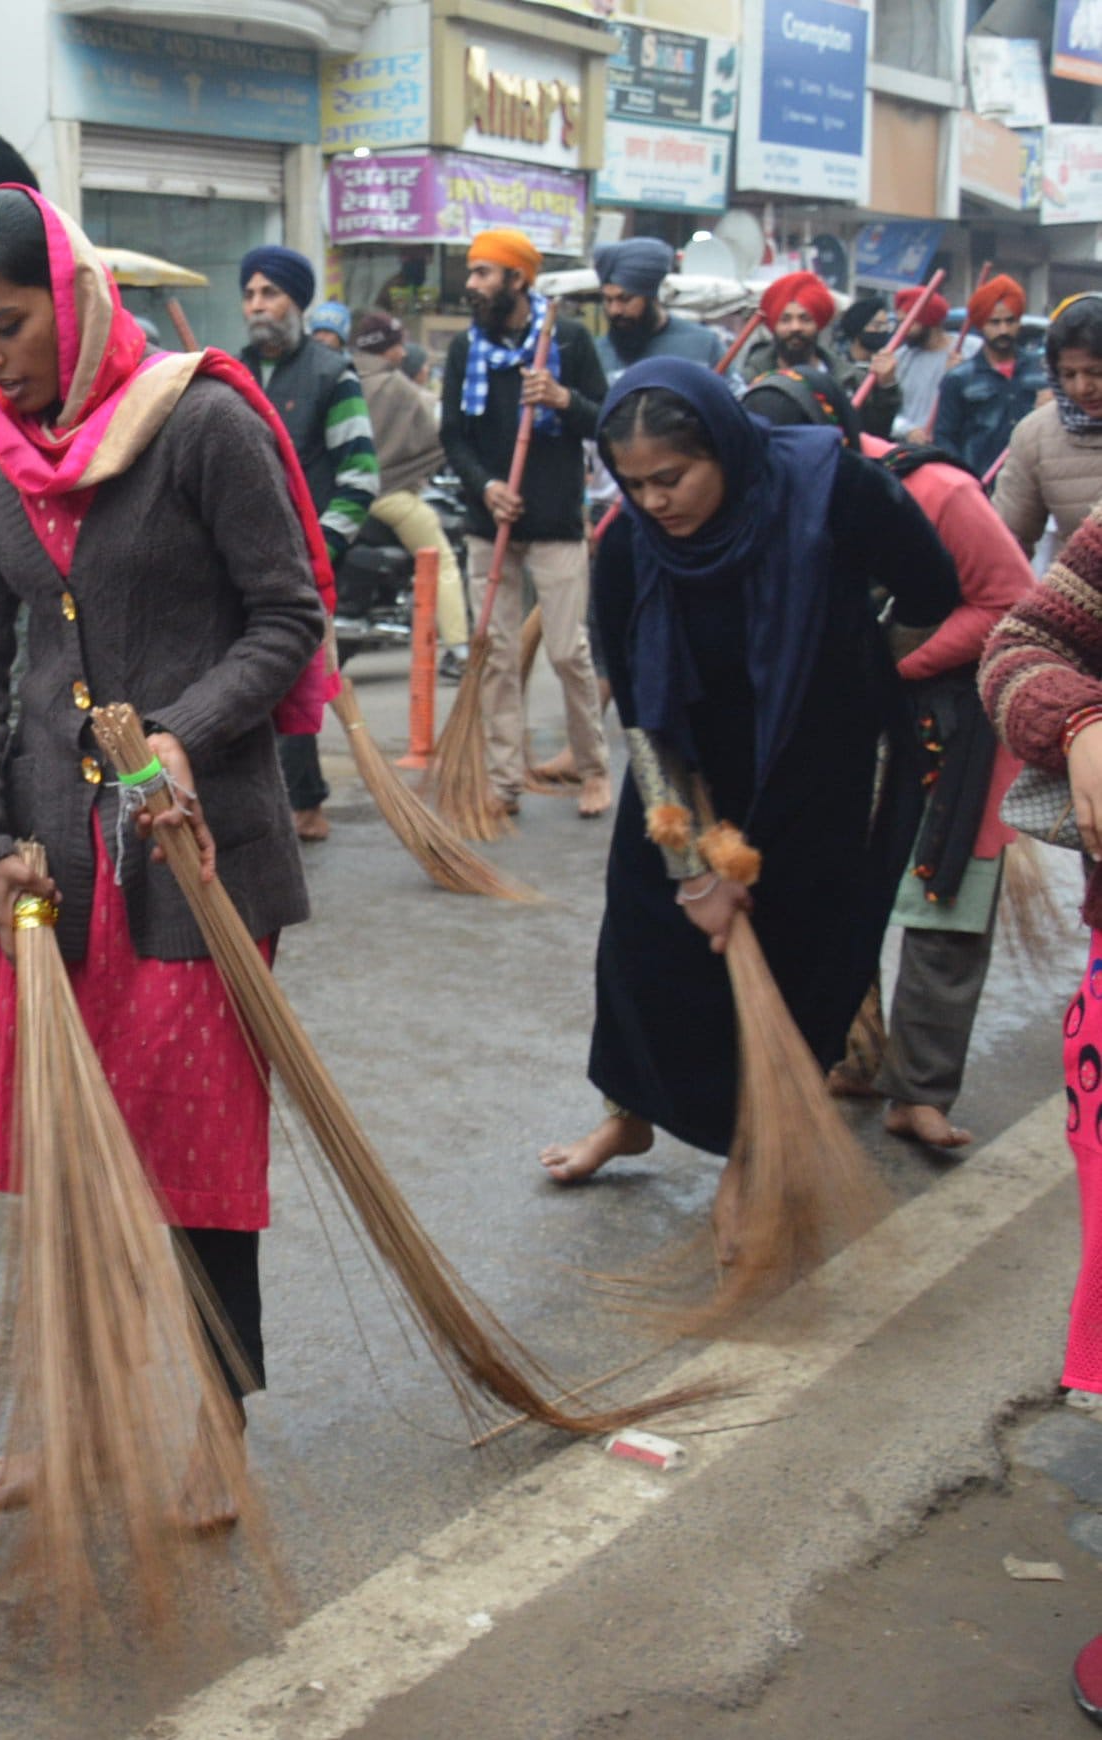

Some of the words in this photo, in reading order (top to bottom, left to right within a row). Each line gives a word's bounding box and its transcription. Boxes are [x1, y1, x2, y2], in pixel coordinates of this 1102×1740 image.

[783, 11, 852, 54] Crompton
[333, 53, 422, 82] अमर
[345, 168, 421, 188] अमर
